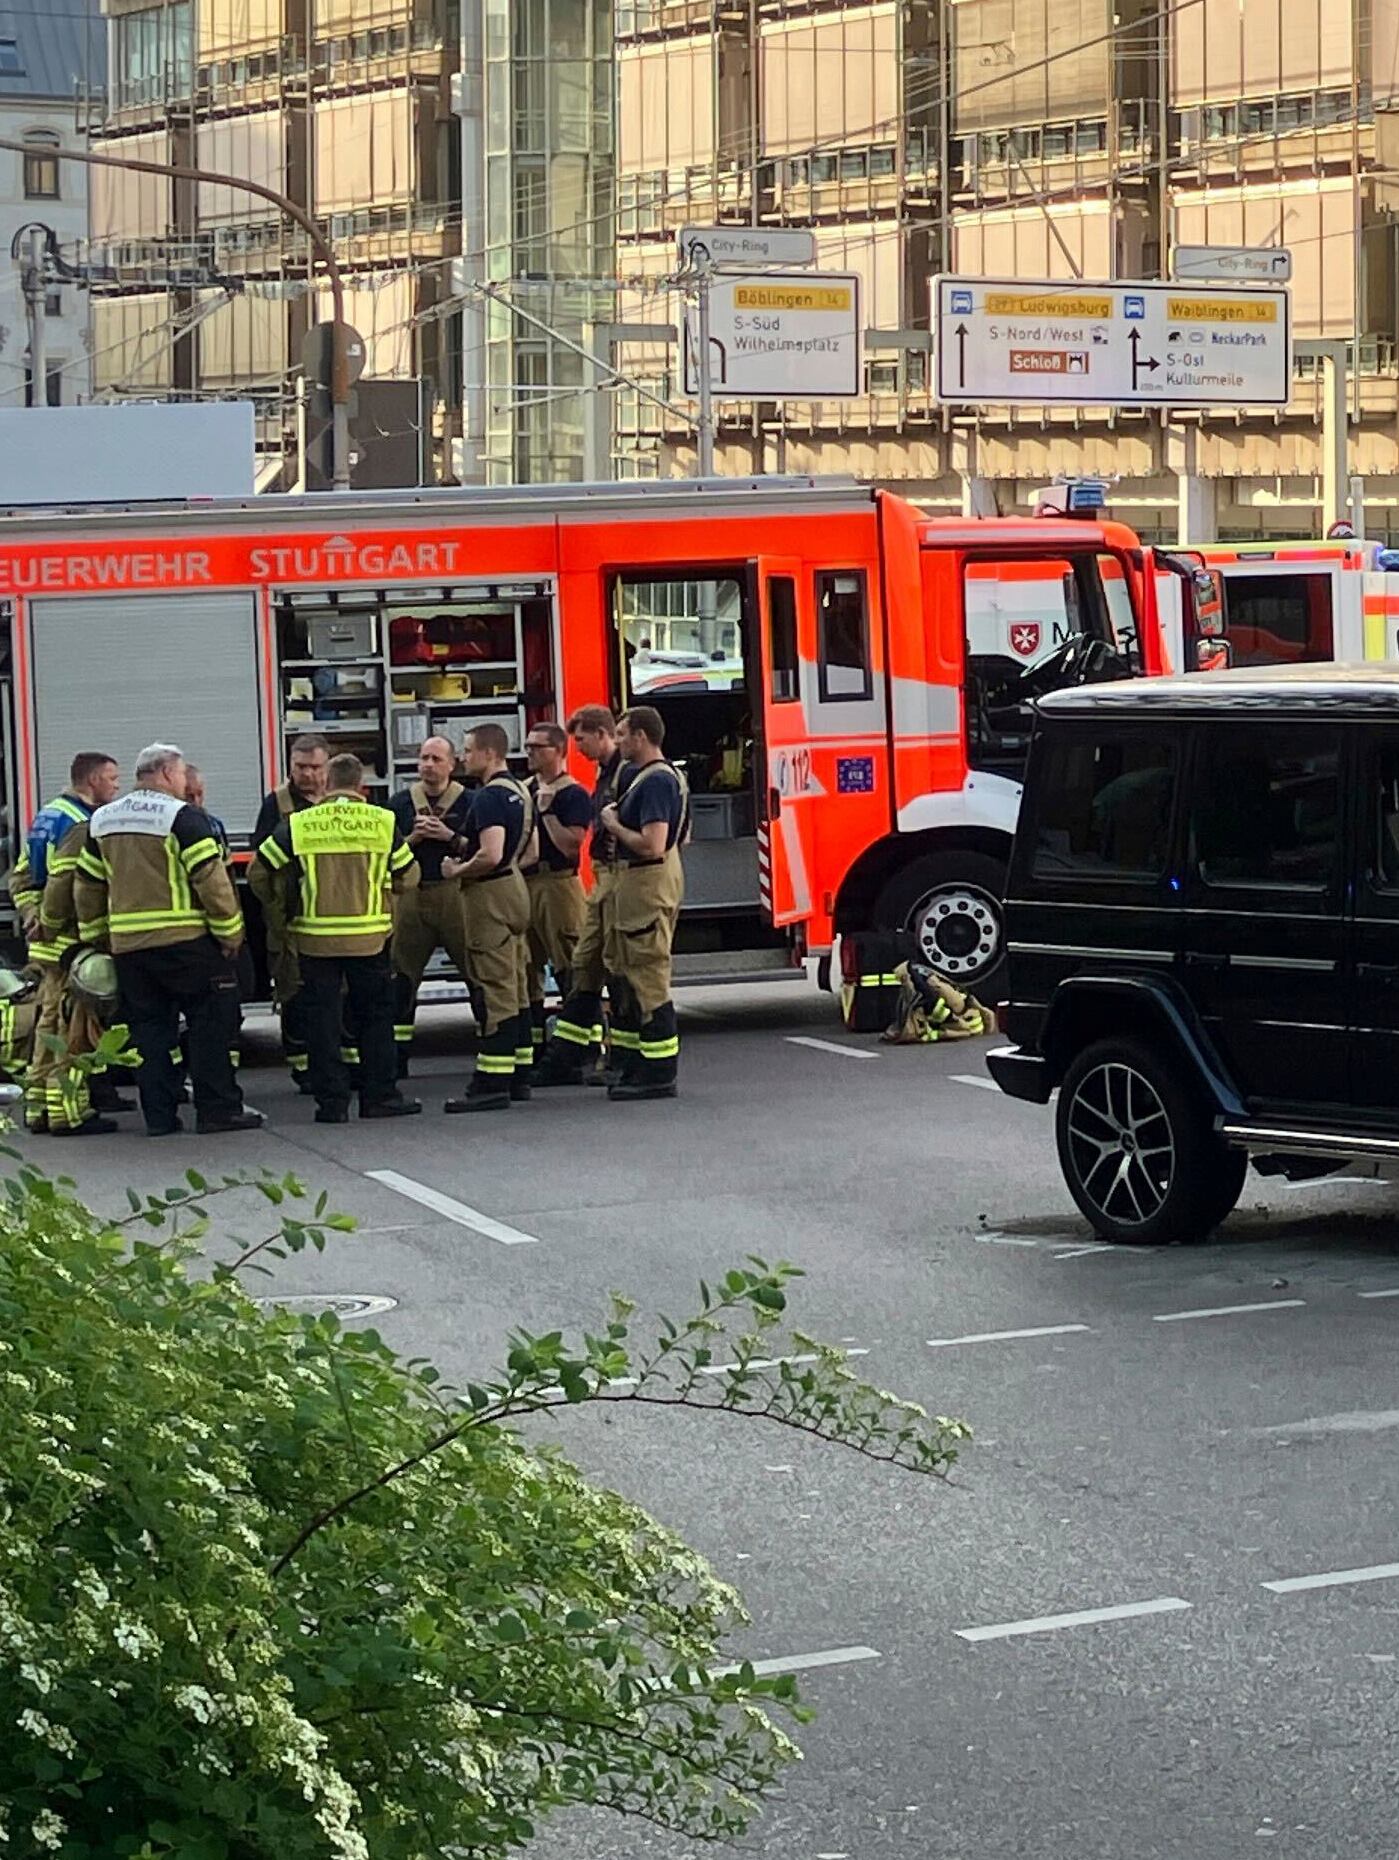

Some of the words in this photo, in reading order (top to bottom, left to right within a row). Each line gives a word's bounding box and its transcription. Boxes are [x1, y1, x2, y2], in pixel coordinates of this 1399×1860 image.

[711, 238, 769, 255] City-Ring
[1217, 257, 1268, 273] City-Ring
[737, 289, 814, 308] Böblingen
[1020, 299, 1110, 318] Ludwigsburg
[1171, 303, 1245, 321] Waiblingen
[734, 315, 780, 331] S-Süd
[990, 326, 1084, 342] S-Nord/West
[734, 336, 840, 354] Wilhelmsplatz
[1013, 352, 1061, 369] Schloß
[1166, 352, 1204, 367] S-Ost
[1166, 372, 1244, 387] Kulturmeile
[249, 536, 460, 579] STUTTGART
[792, 749, 810, 791] 112
